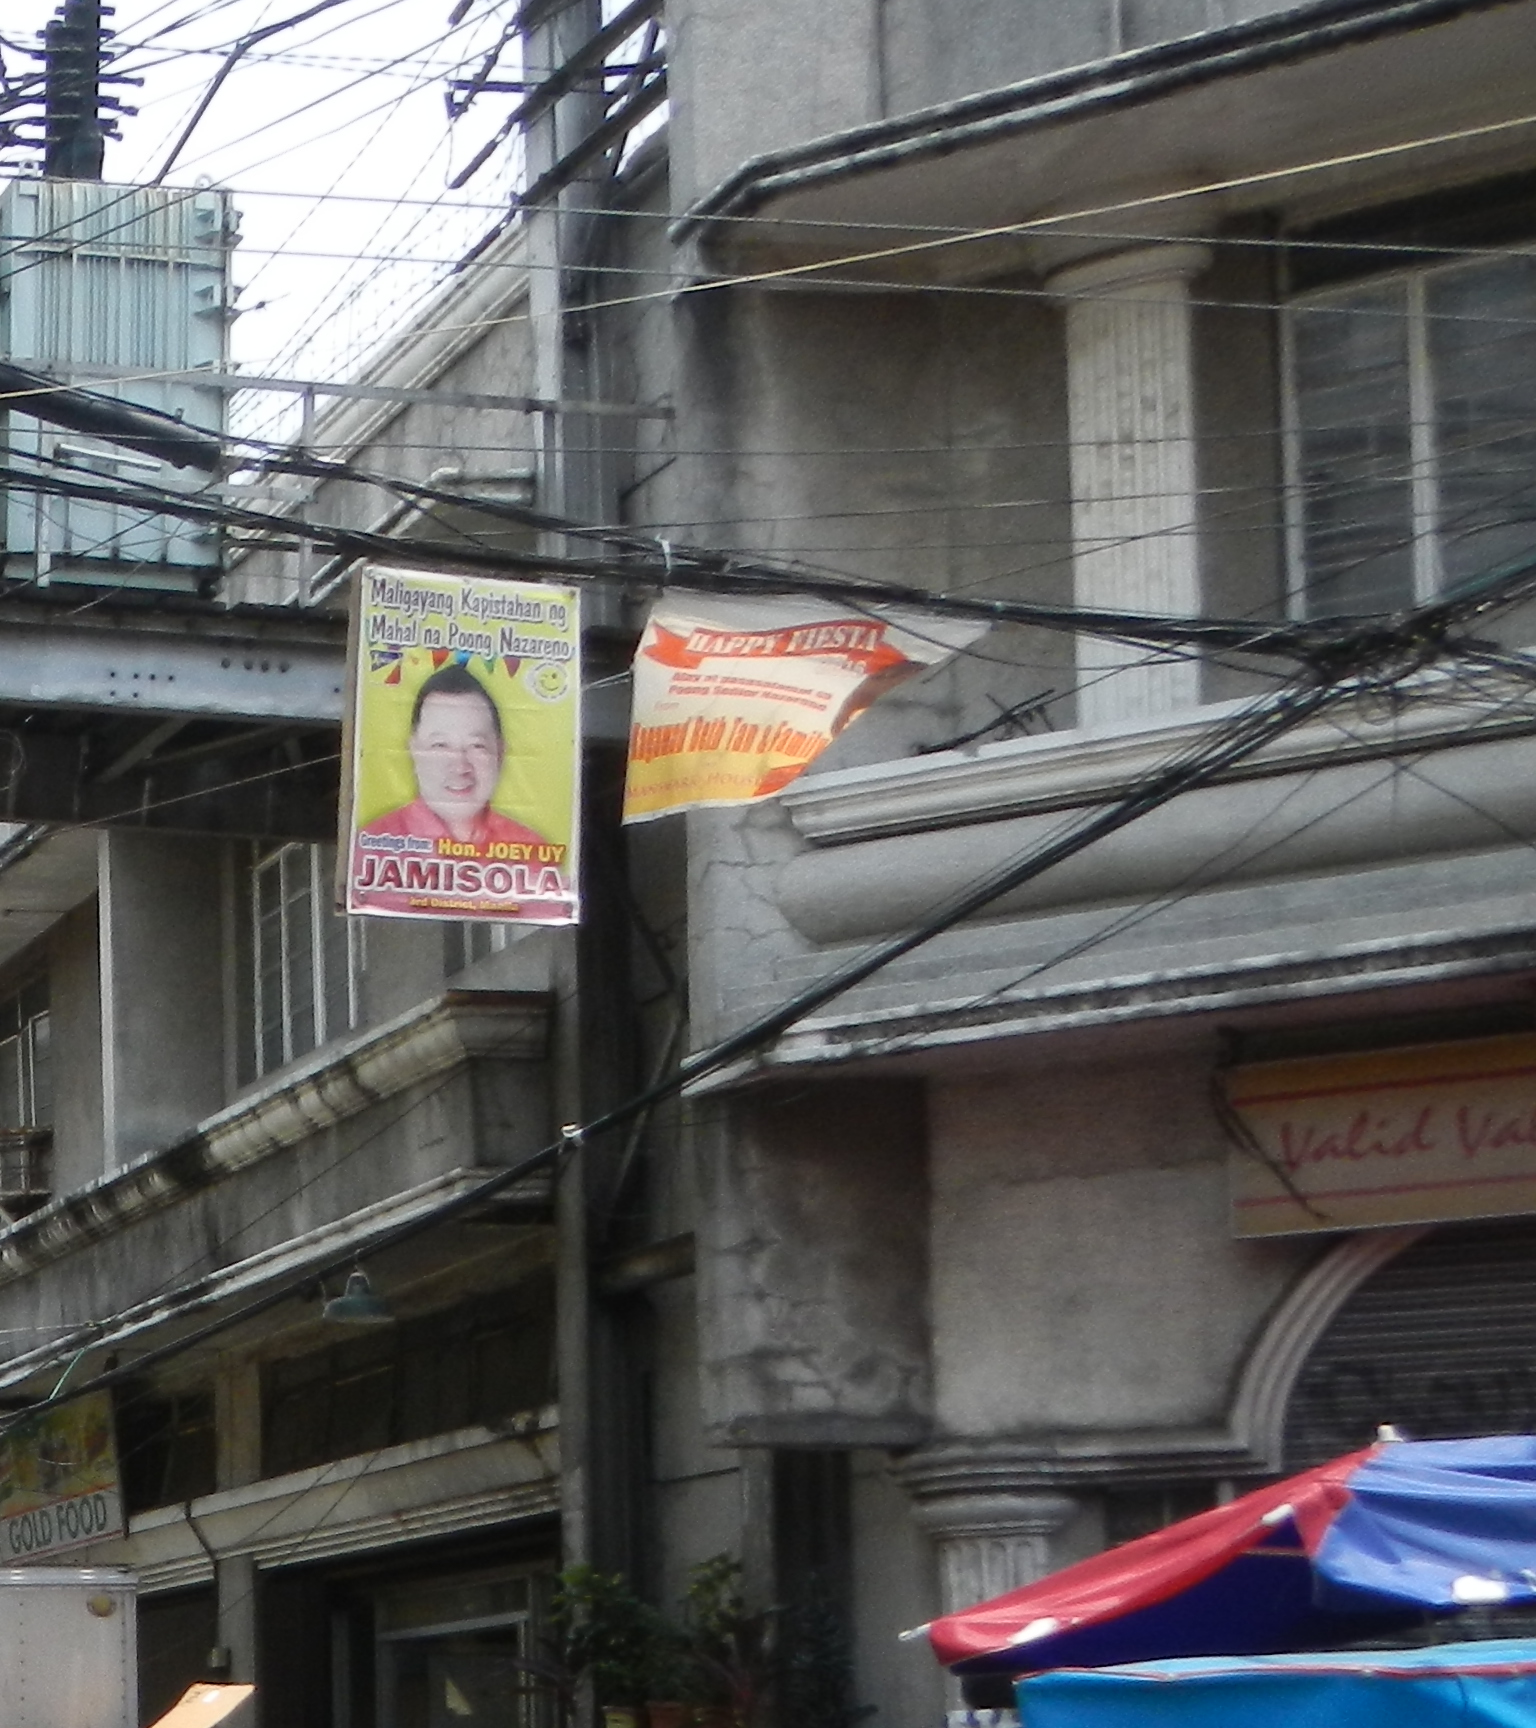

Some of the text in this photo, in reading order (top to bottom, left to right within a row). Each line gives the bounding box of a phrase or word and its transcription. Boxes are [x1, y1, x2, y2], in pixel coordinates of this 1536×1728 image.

[371, 615, 417, 645] Mahal
[424, 628, 441, 645] na
[500, 627, 569, 656] Nazareno
[685, 626, 878, 655] HAPPY FIESTA
[438, 839, 481, 857] Hon.
[486, 842, 537, 860] JOEY
[538, 844, 566, 862] UY
[356, 857, 564, 896] JAMISOLA
[1281, 1106, 1536, 1172] Valid Va
[9, 1493, 107, 1554] GOLD FOOD
